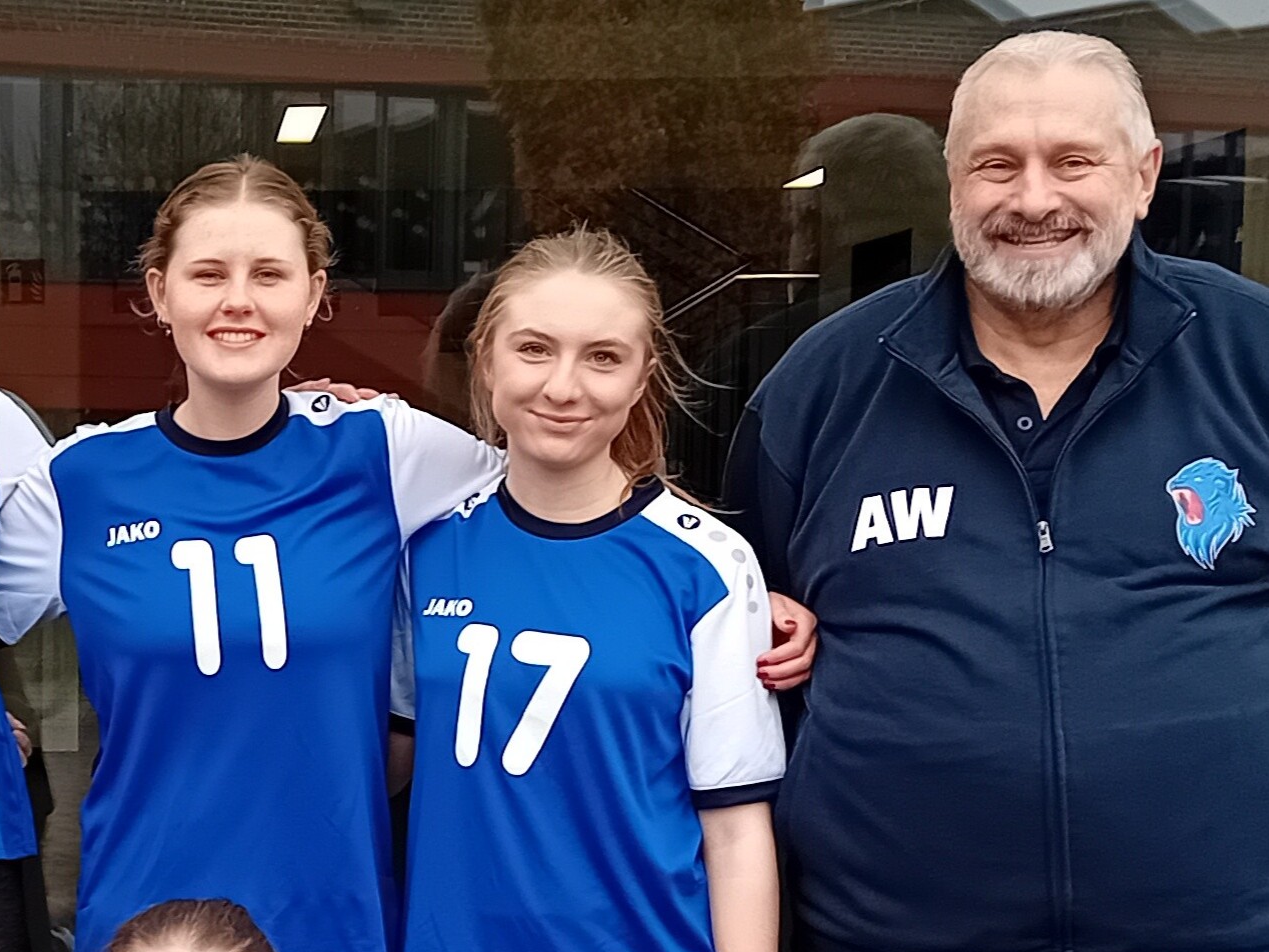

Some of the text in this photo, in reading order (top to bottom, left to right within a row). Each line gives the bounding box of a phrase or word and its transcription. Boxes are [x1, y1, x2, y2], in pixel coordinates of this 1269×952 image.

[106, 520, 161, 547] JAKO
[850, 485, 954, 553] AW
[170, 534, 288, 676] 11
[422, 598, 473, 618] JAKO
[455, 623, 591, 776] 17
